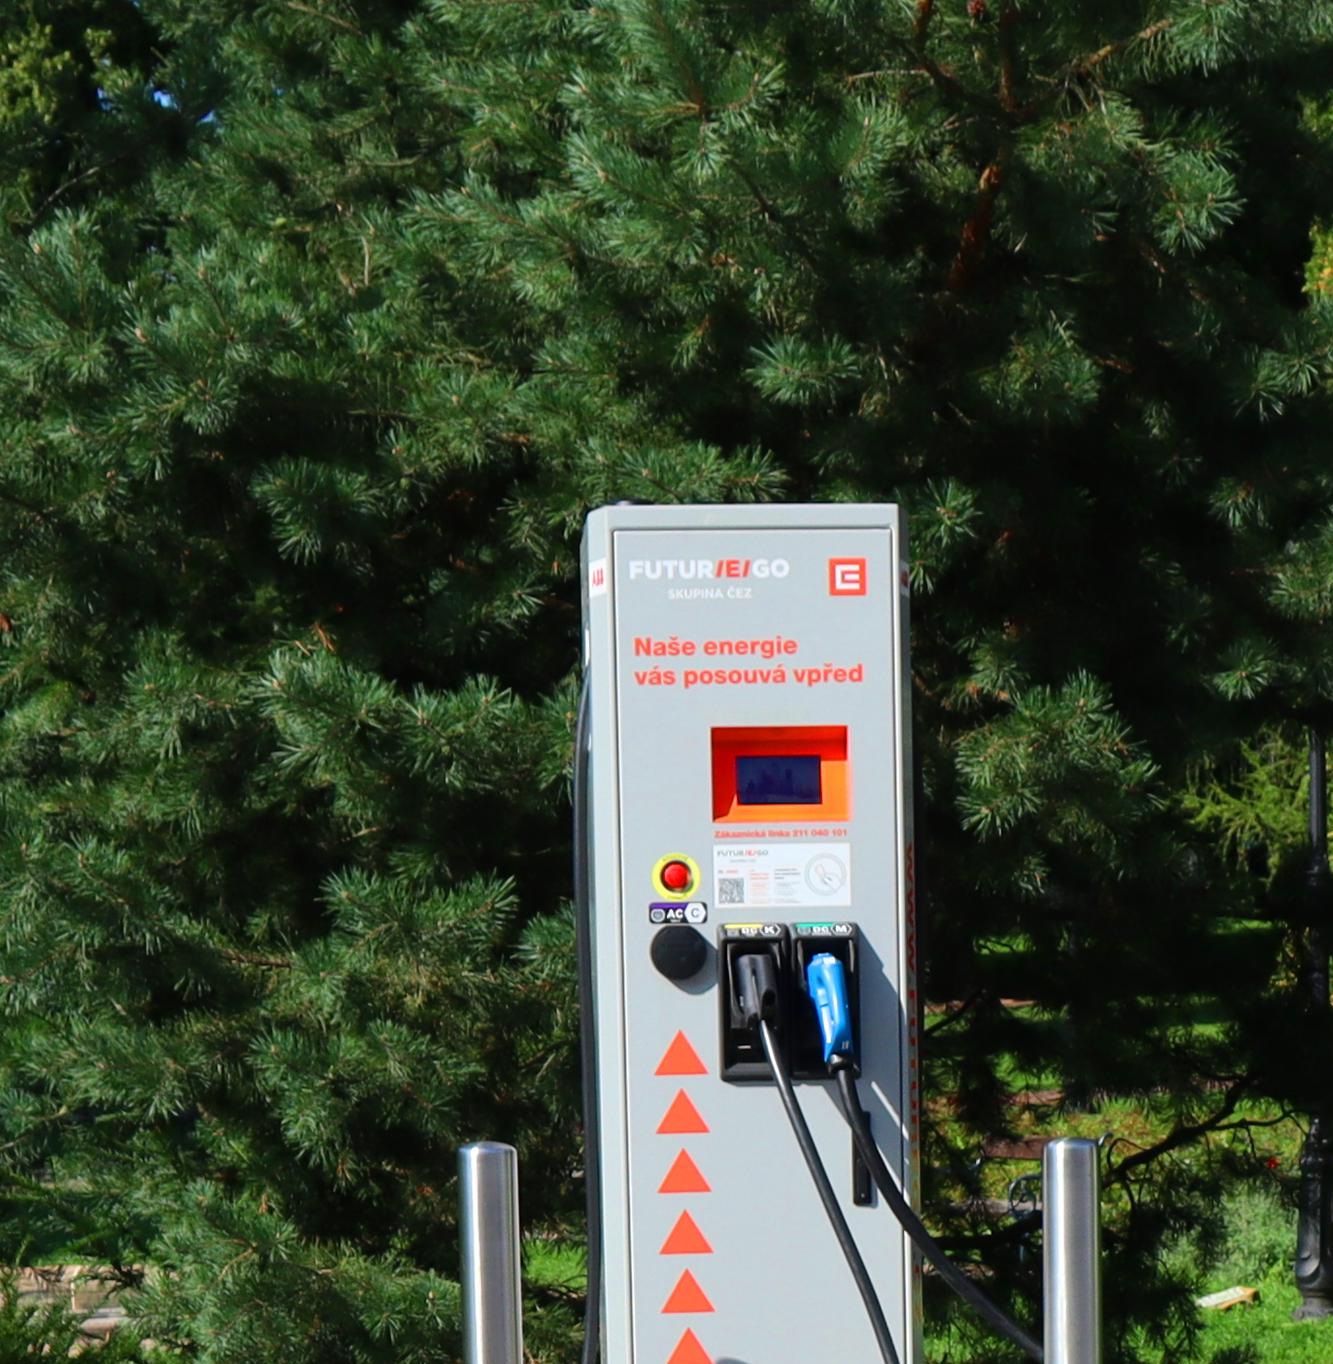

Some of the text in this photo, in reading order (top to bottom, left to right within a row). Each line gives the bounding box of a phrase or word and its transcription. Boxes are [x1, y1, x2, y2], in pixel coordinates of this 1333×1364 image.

[667, 585, 753, 600] SKUPINA ČEZ
[634, 635, 798, 659] Naše energie
[634, 663, 864, 689] vás posouvá vpřed
[666, 907, 700, 919] AC C
